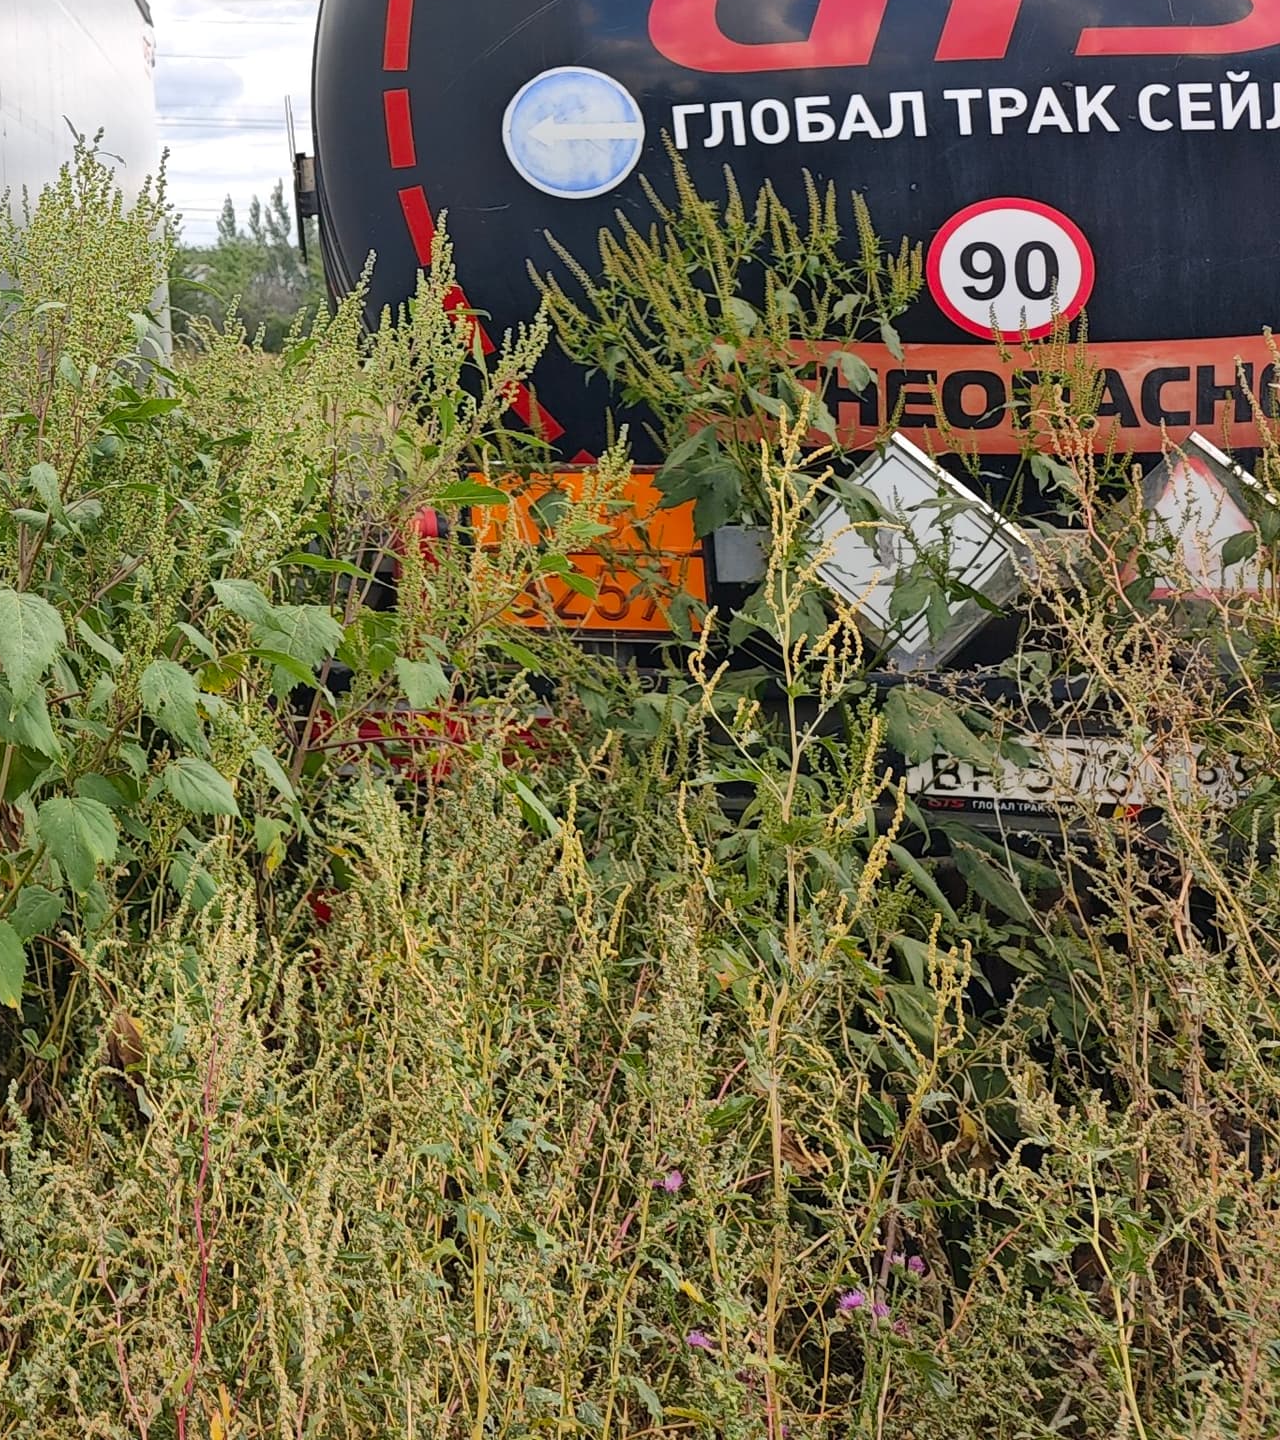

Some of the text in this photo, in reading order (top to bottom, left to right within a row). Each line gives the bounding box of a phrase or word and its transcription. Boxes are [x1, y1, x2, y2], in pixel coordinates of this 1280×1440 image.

[671, 90, 929, 150] ГЛОБАЛ
[943, 85, 1121, 136] ТРАК
[960, 240, 1060, 301] 90
